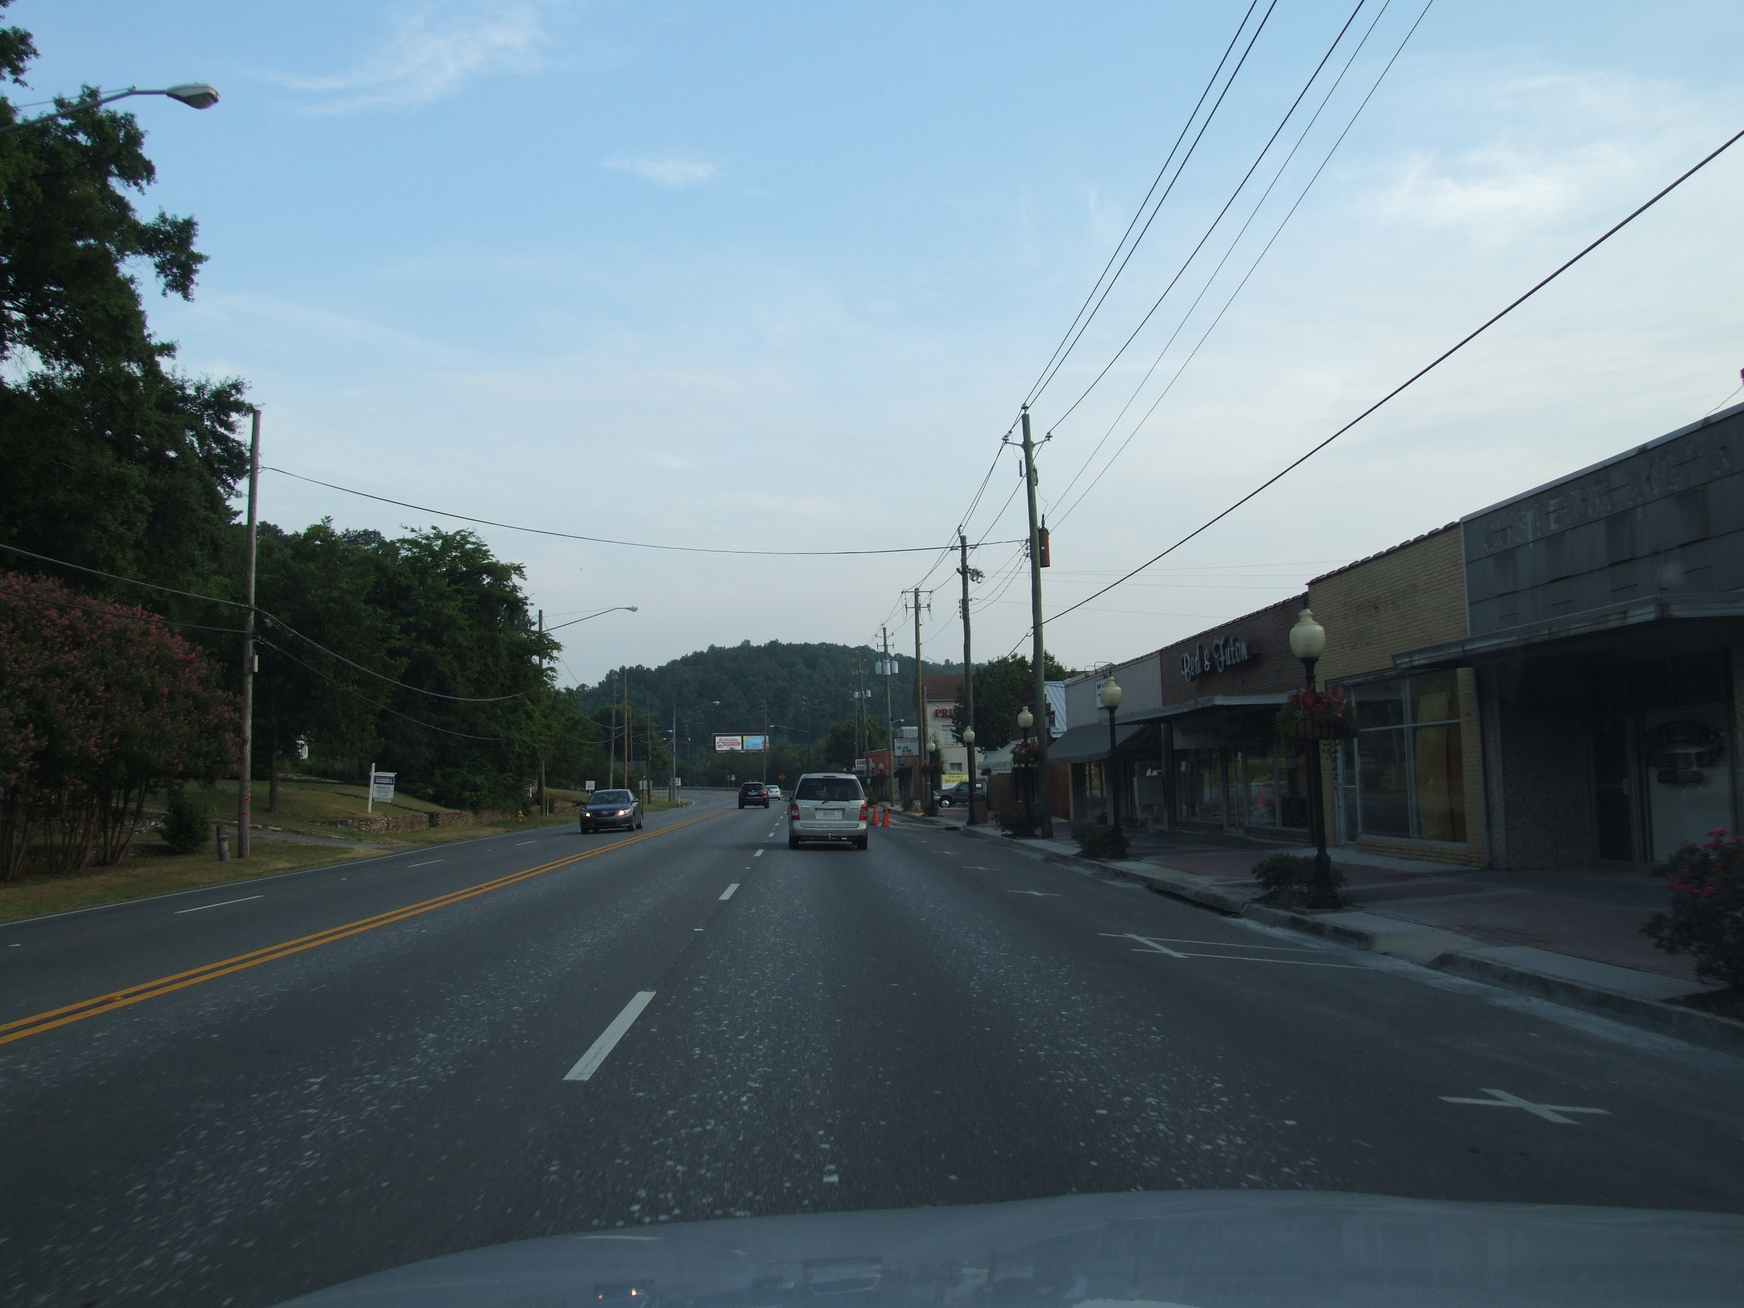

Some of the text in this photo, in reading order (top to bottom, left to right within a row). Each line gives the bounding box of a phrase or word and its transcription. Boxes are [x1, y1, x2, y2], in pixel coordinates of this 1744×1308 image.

[1181, 636, 1248, 682] Bed & Futon
